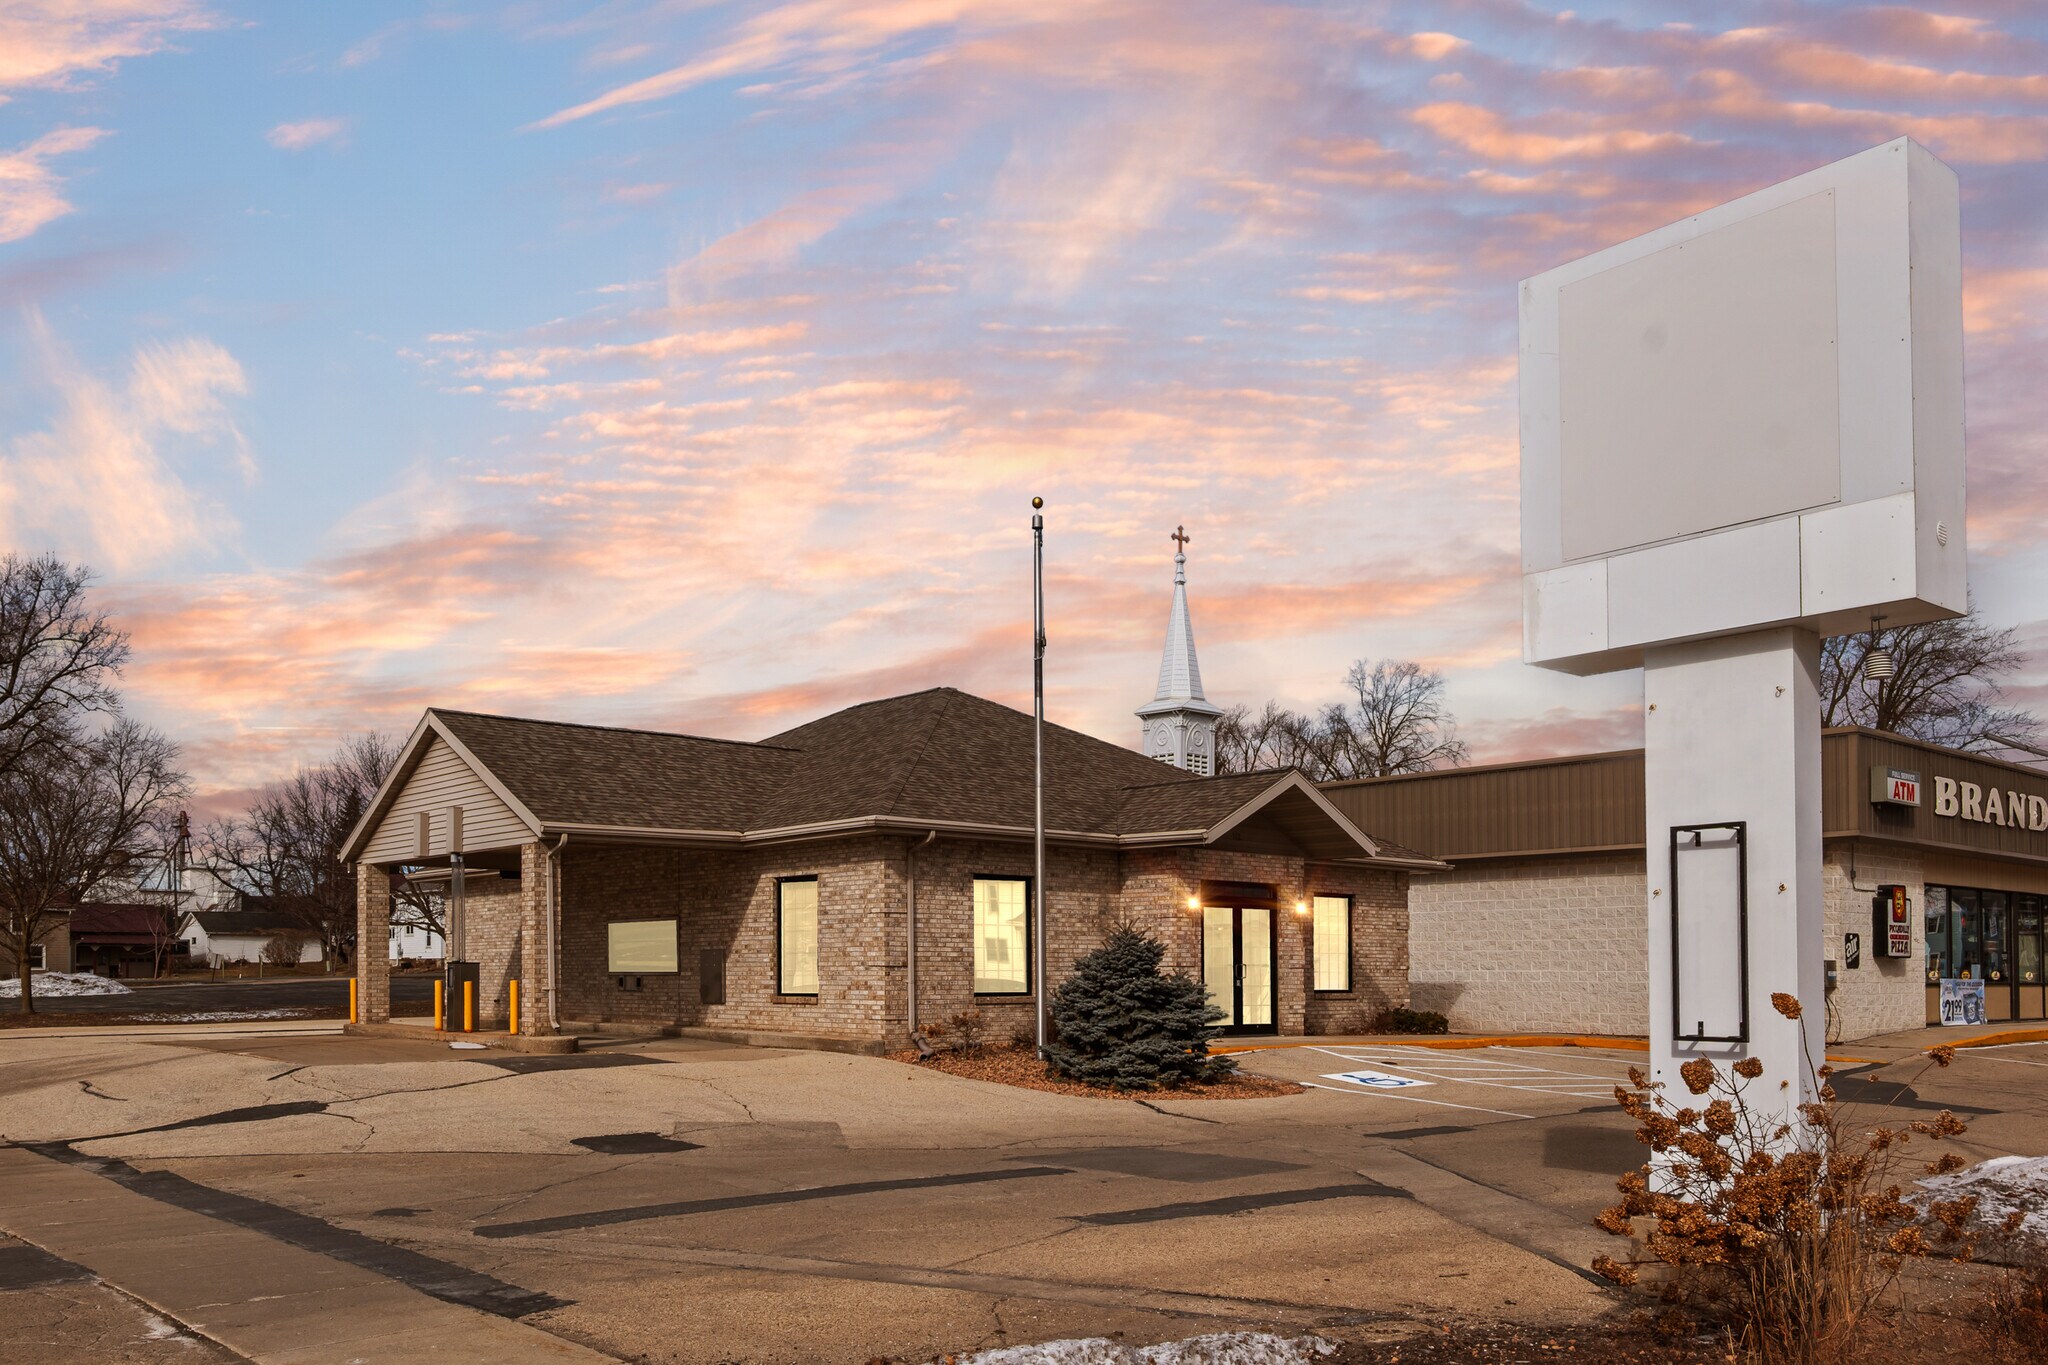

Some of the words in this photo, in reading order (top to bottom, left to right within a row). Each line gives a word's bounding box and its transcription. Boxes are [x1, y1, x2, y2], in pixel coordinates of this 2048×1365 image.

[1893, 781, 1915, 802] ATM
[1845, 934, 1858, 958] air
[1891, 940, 1909, 954] PIZZA
